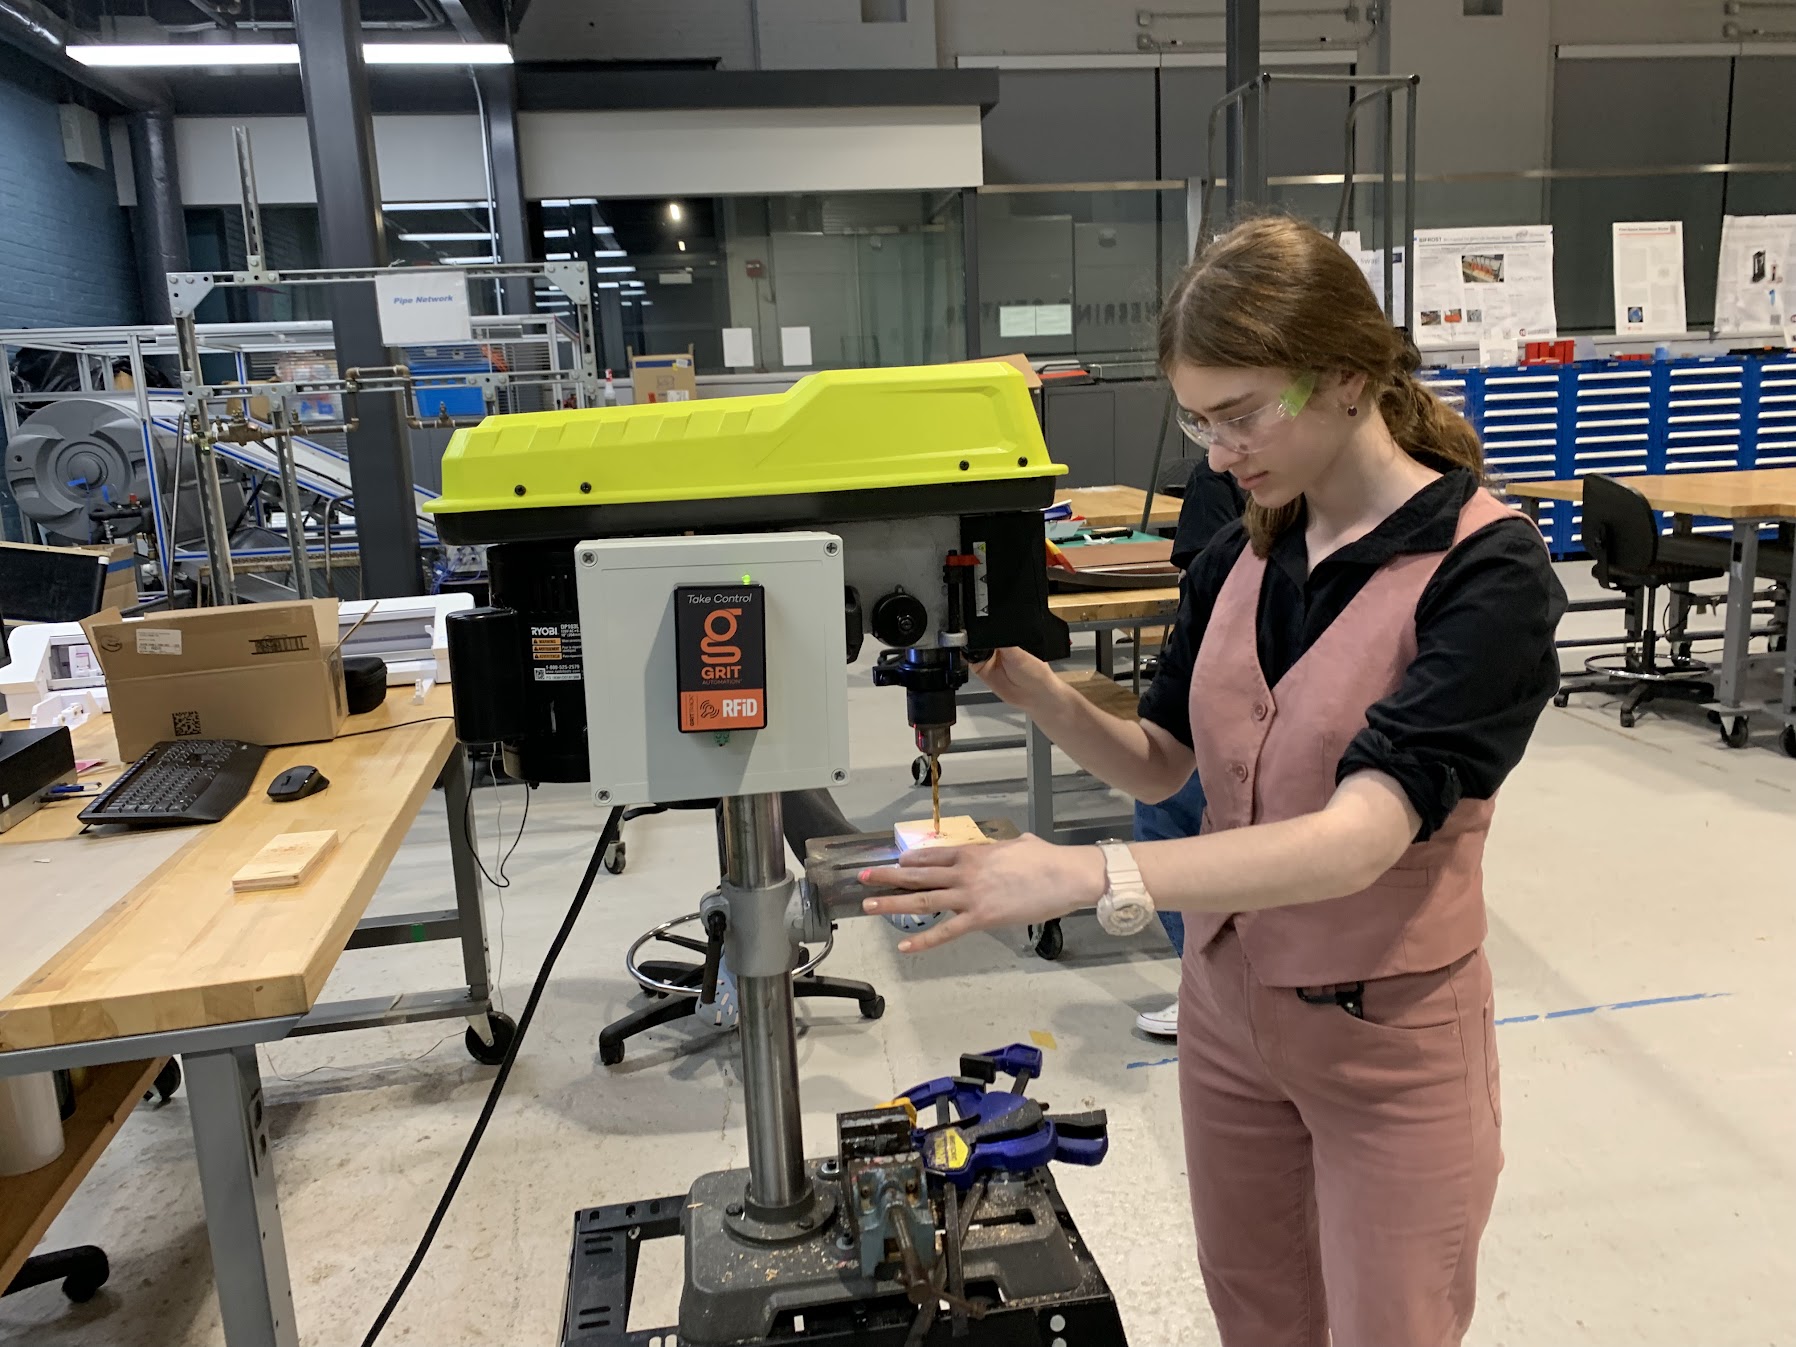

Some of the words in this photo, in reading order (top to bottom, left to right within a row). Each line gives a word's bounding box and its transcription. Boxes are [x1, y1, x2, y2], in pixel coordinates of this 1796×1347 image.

[393, 297, 413, 305] Pipe
[416, 294, 454, 304] Network
[687, 594, 711, 604] Take
[713, 593, 753, 604] Control
[531, 626, 558, 636] RYOBI
[701, 665, 742, 680] GRIT
